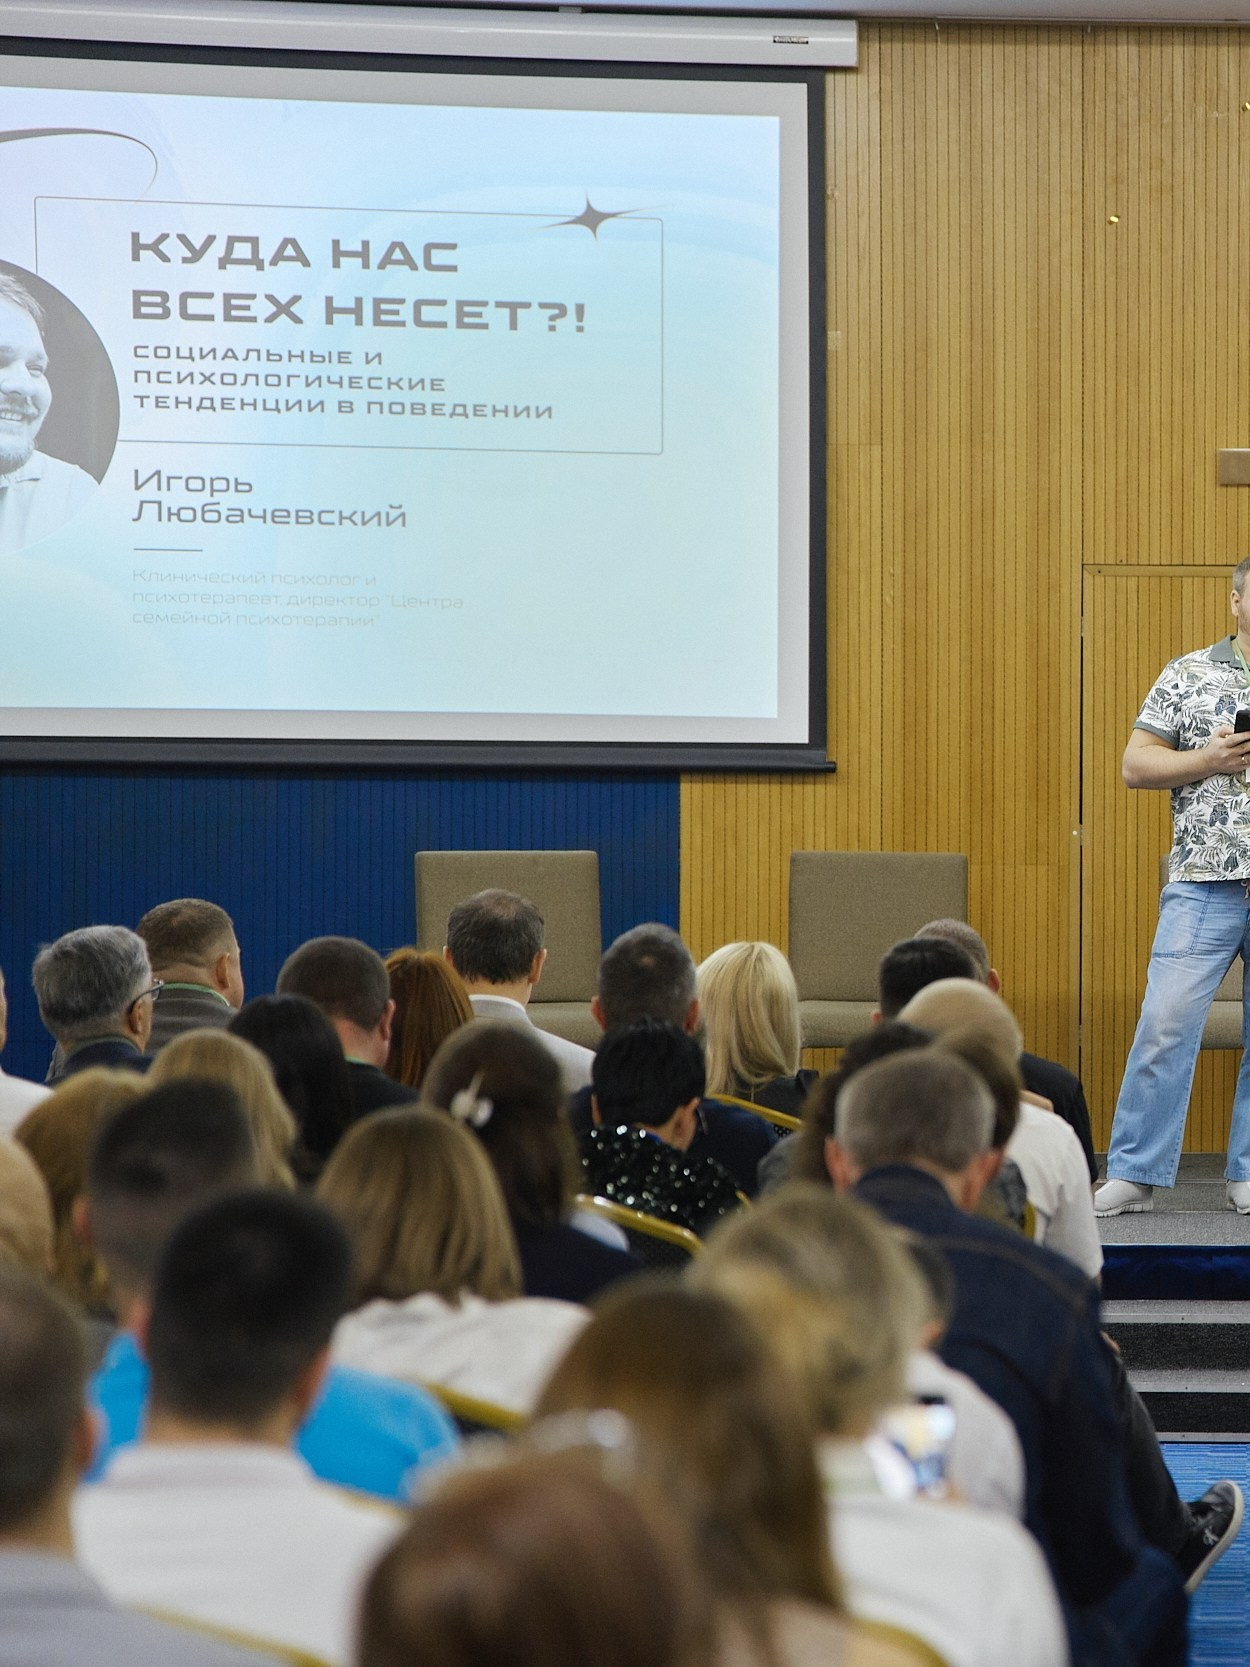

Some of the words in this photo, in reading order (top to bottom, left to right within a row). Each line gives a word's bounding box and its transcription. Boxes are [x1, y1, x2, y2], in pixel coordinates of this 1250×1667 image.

[130, 231, 312, 272] КУДА
[331, 238, 459, 273] НАС
[131, 289, 304, 325] ВСЕХ
[325, 295, 586, 333] НЕСЕТ?!
[132, 344, 353, 366] СОЦИАЛЬНЫЕ
[364, 351, 383, 366] И
[133, 369, 446, 392] ПСИХОЛОГИЧЕСКИЕ
[133, 394, 326, 414] ТЕНДЕНЦИИ
[337, 400, 355, 415] В
[366, 400, 554, 420] ПОВЕДЕНИИ
[133, 468, 254, 498] Игорь
[131, 499, 407, 528] Любачевский
[132, 568, 266, 585] Клинический
[271, 572, 361, 587] психолог
[286, 593, 381, 609] директор
[132, 610, 231, 625] семейной
